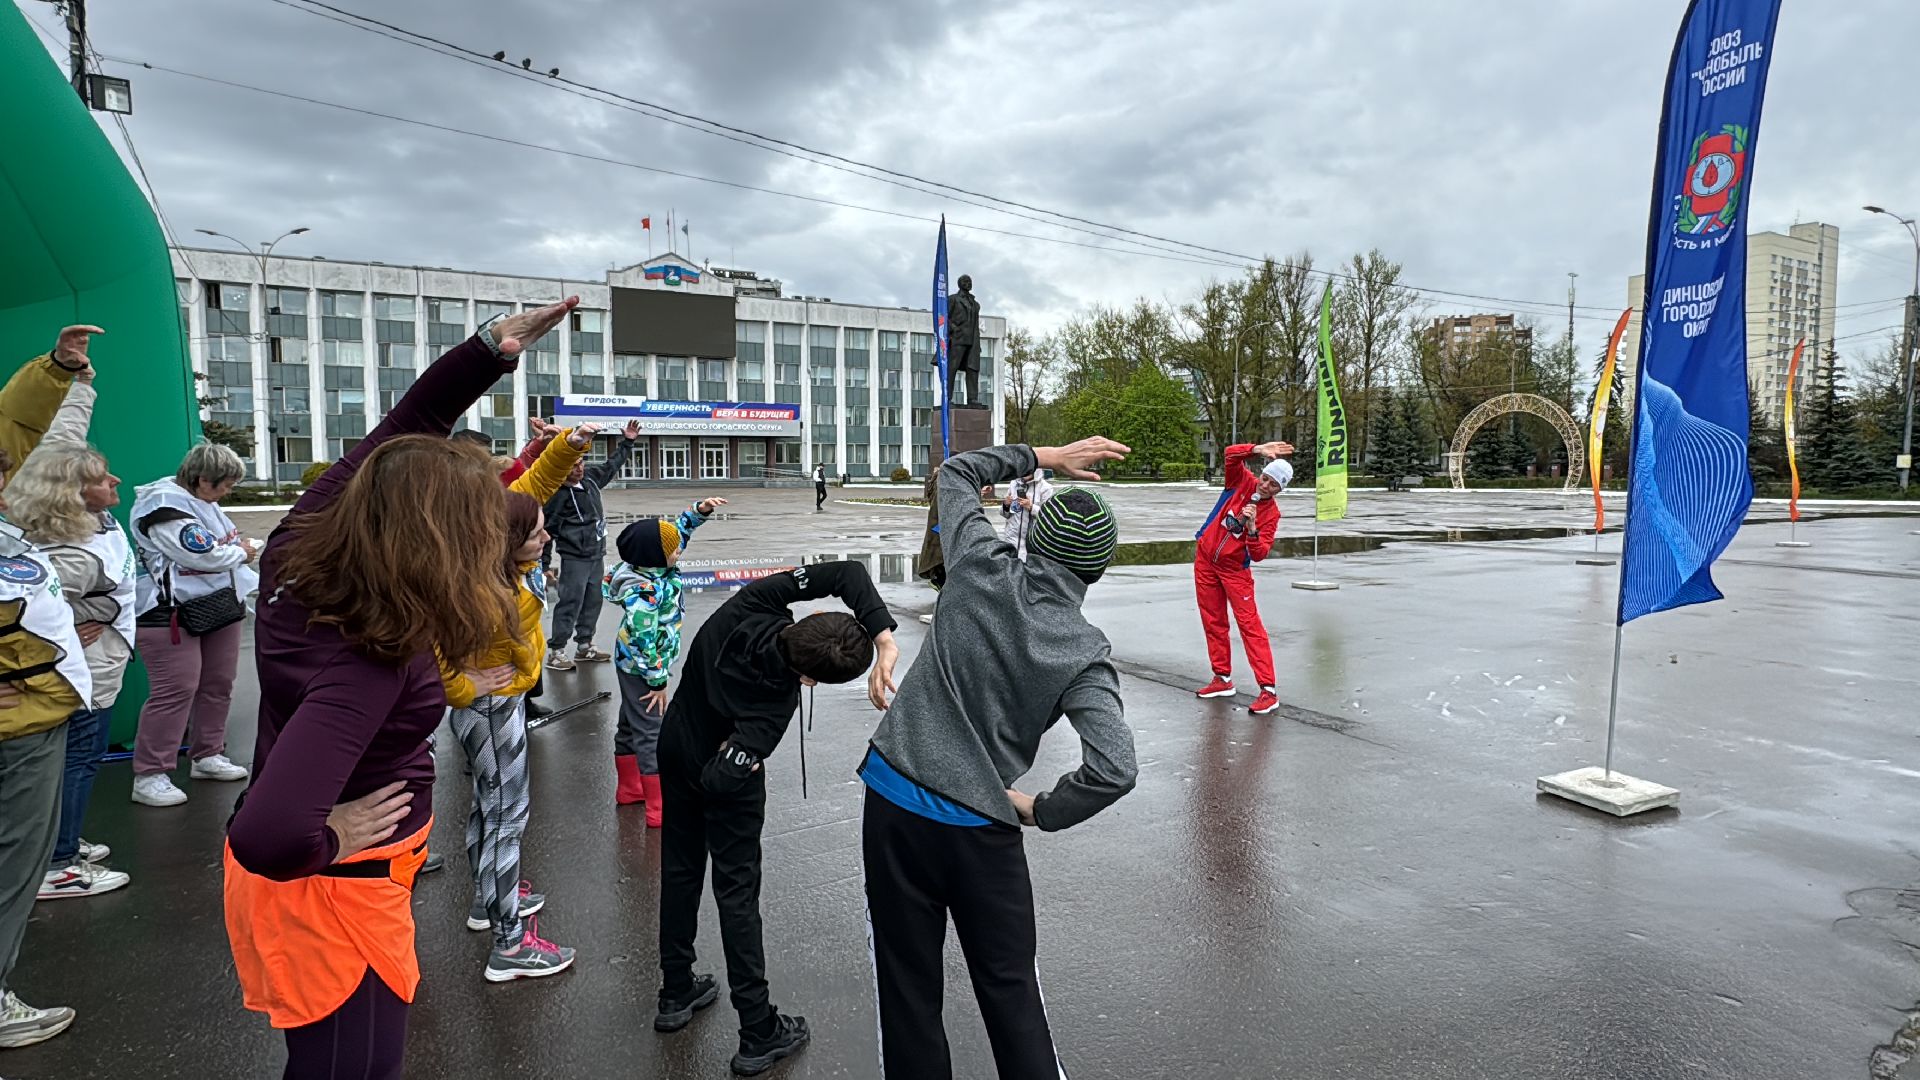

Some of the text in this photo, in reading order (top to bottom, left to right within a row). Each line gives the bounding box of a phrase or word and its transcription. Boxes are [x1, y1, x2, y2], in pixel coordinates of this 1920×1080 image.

[1707, 29, 1742, 58] ОЮЗ
[1701, 65, 1746, 97] ОССИИ
[583, 396, 628, 405] ГОРДОСТЬ
[645, 403, 712, 412] УВЕРЕННОСТЬ
[716, 409, 740, 418] ВЕРА
[740, 410, 748, 418] В
[708, 423, 757, 431] ГОРОДСКОГО
